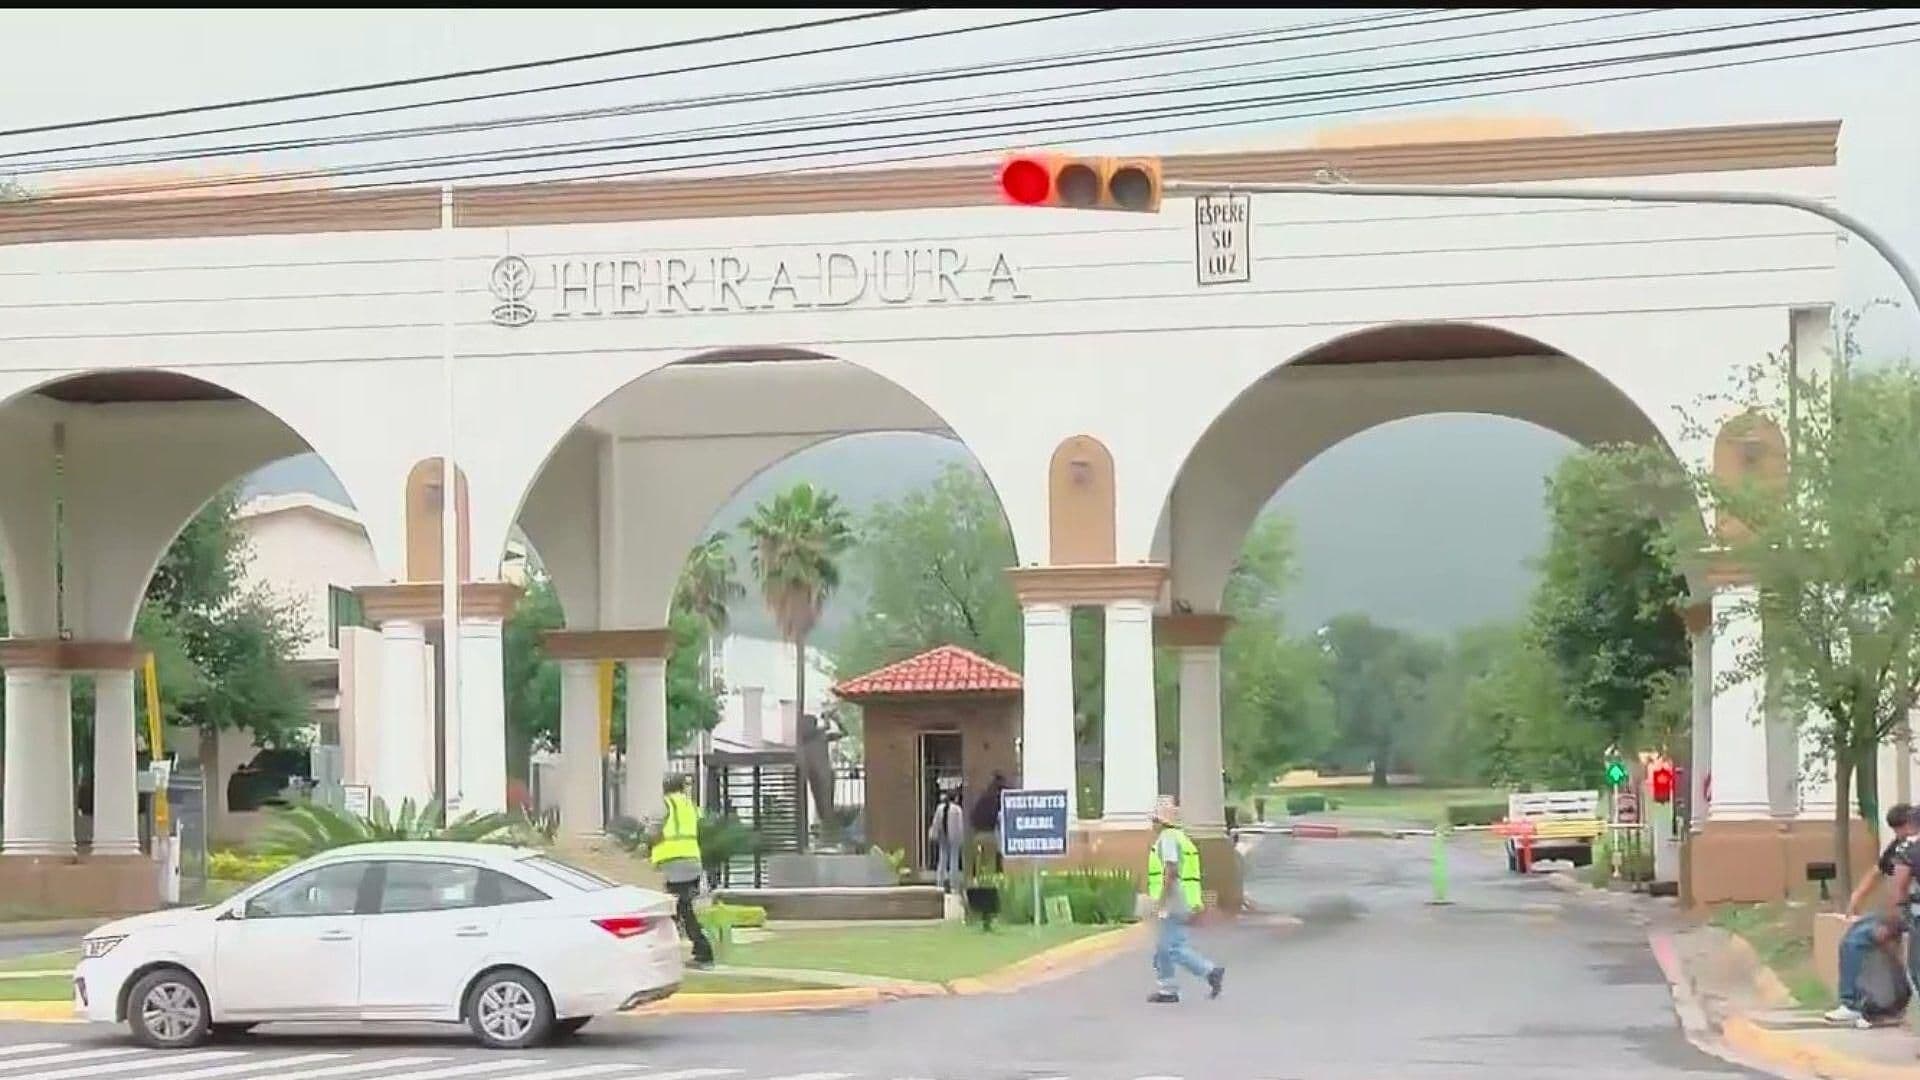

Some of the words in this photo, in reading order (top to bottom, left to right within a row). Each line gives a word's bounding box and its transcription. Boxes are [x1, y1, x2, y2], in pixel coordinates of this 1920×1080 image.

[1199, 204, 1244, 225] ESPERE
[1212, 229, 1232, 248] SU
[1208, 253, 1237, 275] LUZ
[552, 248, 1031, 318] HERRADURA
